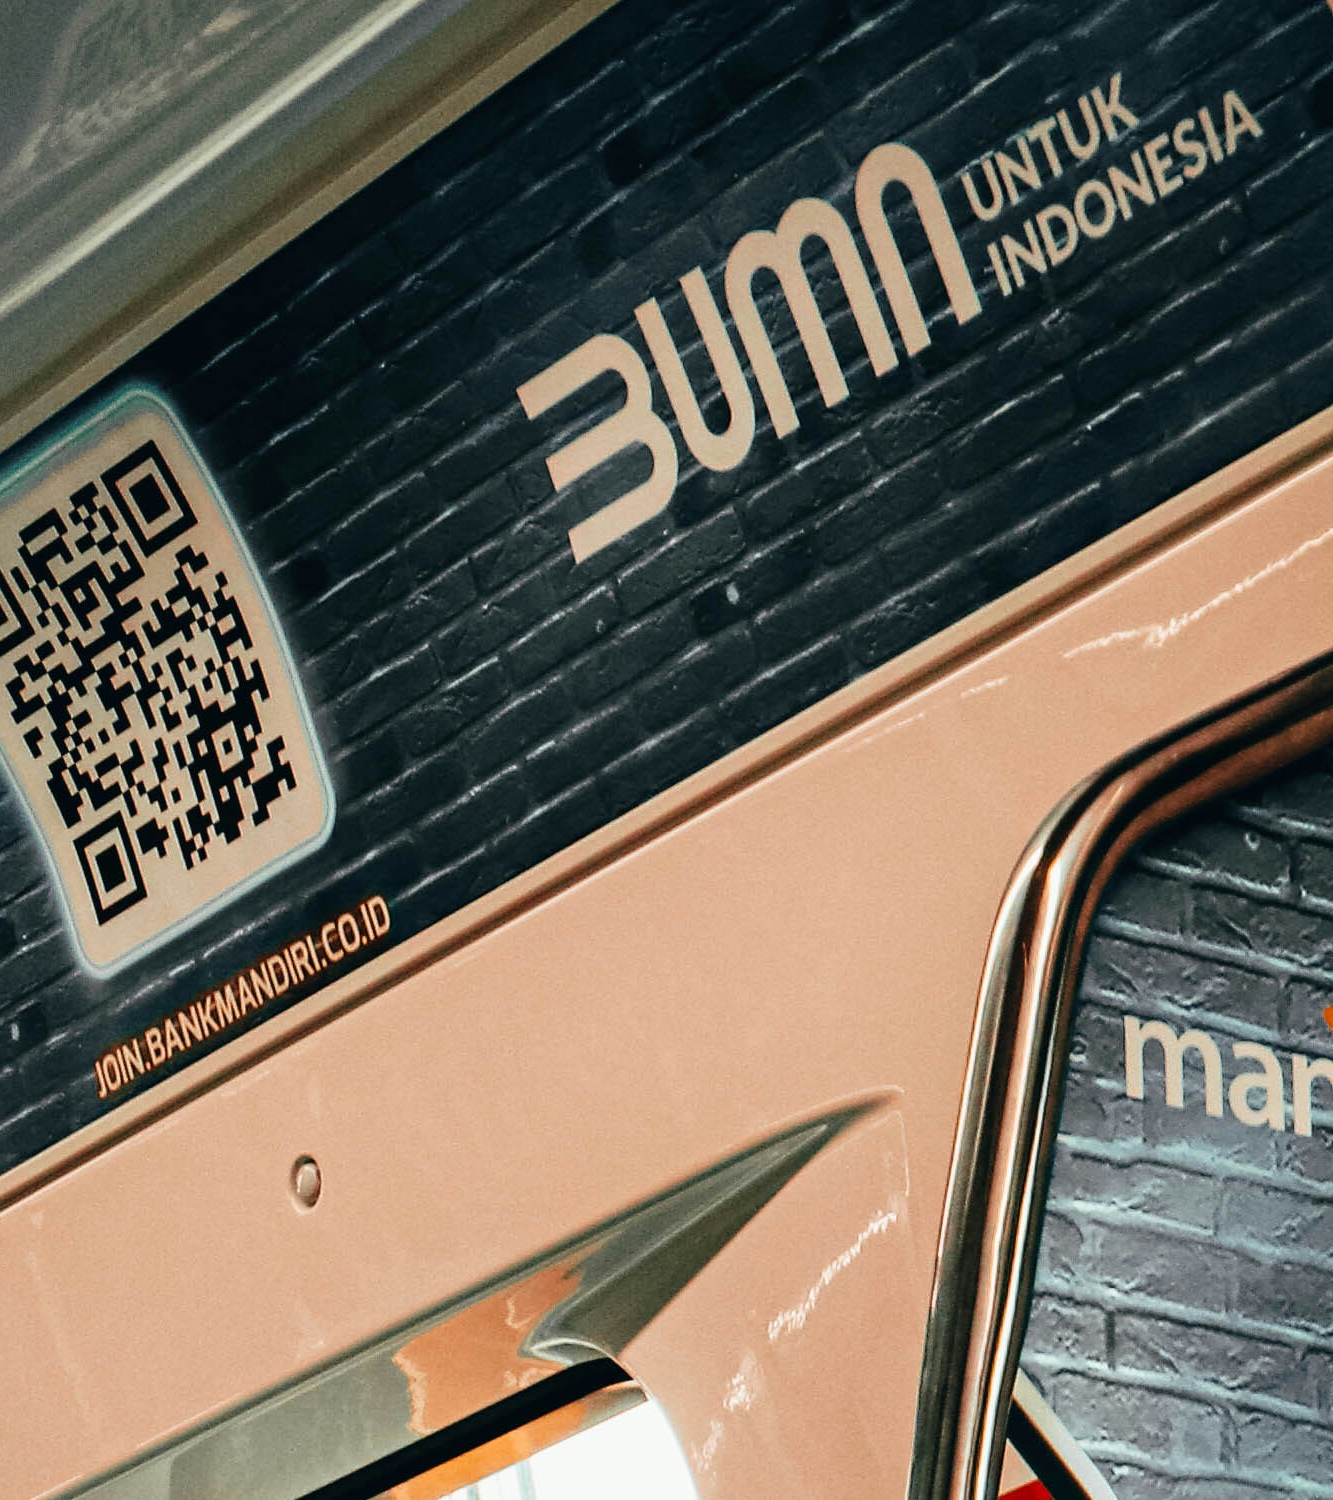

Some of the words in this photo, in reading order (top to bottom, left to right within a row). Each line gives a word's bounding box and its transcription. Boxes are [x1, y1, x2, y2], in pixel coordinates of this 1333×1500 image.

[959, 71, 1140, 223] UNTUK
[986, 89, 1264, 296] INDONESIA
[516, 141, 982, 566] BUMN
[93, 895, 392, 1101] JOIN.BANKMANDIRI.CO.ID
